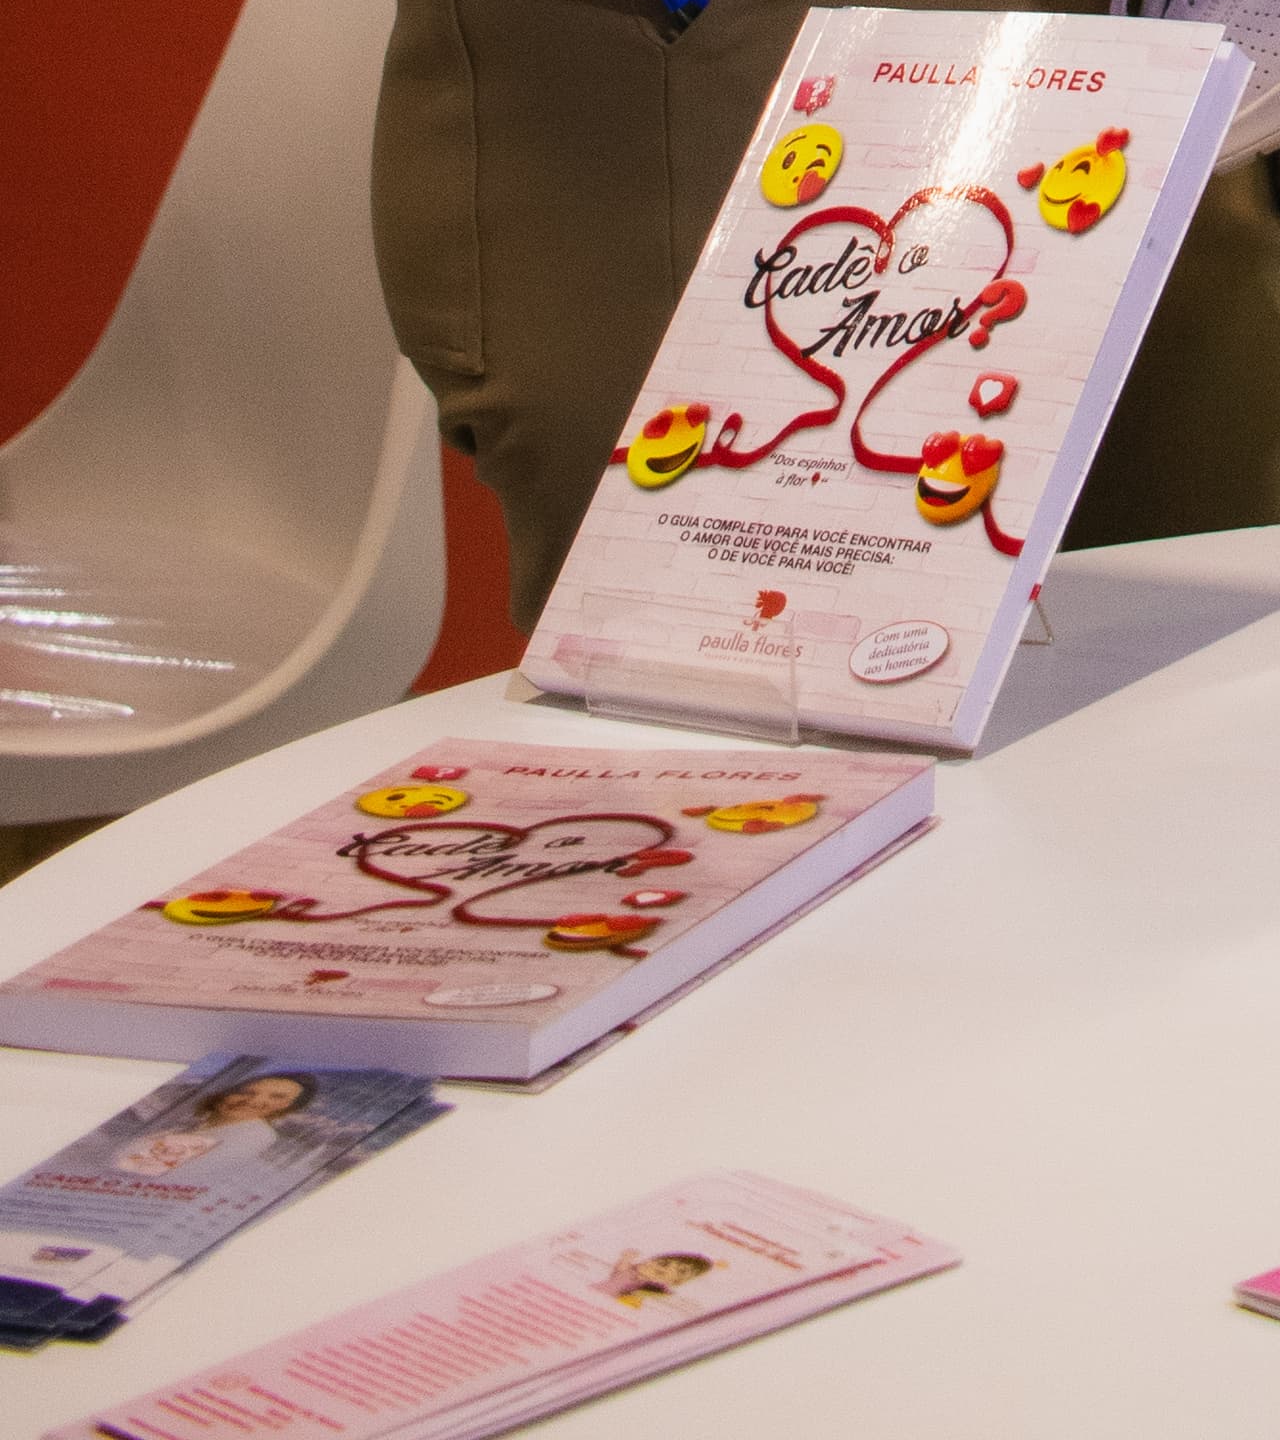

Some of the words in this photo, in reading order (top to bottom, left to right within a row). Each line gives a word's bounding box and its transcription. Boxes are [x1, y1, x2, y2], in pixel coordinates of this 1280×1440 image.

[873, 62, 978, 85] PAULLA
[1003, 66, 1107, 93] ORES
[744, 236, 875, 308] Cadê
[798, 456, 848, 472] espinhos
[658, 513, 668, 525] O
[670, 514, 700, 528] GUIA
[703, 518, 773, 536] COMPLETO
[775, 525, 808, 539] PARA
[812, 528, 849, 543] VOCÊ
[850, 534, 931, 553] ENCONTRAR
[679, 530, 689, 542] O
[691, 532, 730, 547] AMOR
[733, 535, 760, 550] QUE
[764, 538, 799, 554] VOCÊ
[801, 544, 833, 558] MAIS
[836, 546, 895, 564] PRECISA:
[707, 548, 718, 560] O
[720, 549, 738, 562] DE
[741, 550, 776, 566] VOCÊ
[778, 556, 812, 571] PARA
[815, 559, 856, 575] VOCÊ!
[698, 633, 749, 652] paulla
[753, 633, 803, 658] flores
[874, 631, 901, 645] Com
[903, 627, 929, 640] uma
[868, 640, 930, 660] dedicatória
[863, 663, 882, 676] aos
[503, 765, 647, 780] PAULLA
[656, 769, 802, 781] FLORES
